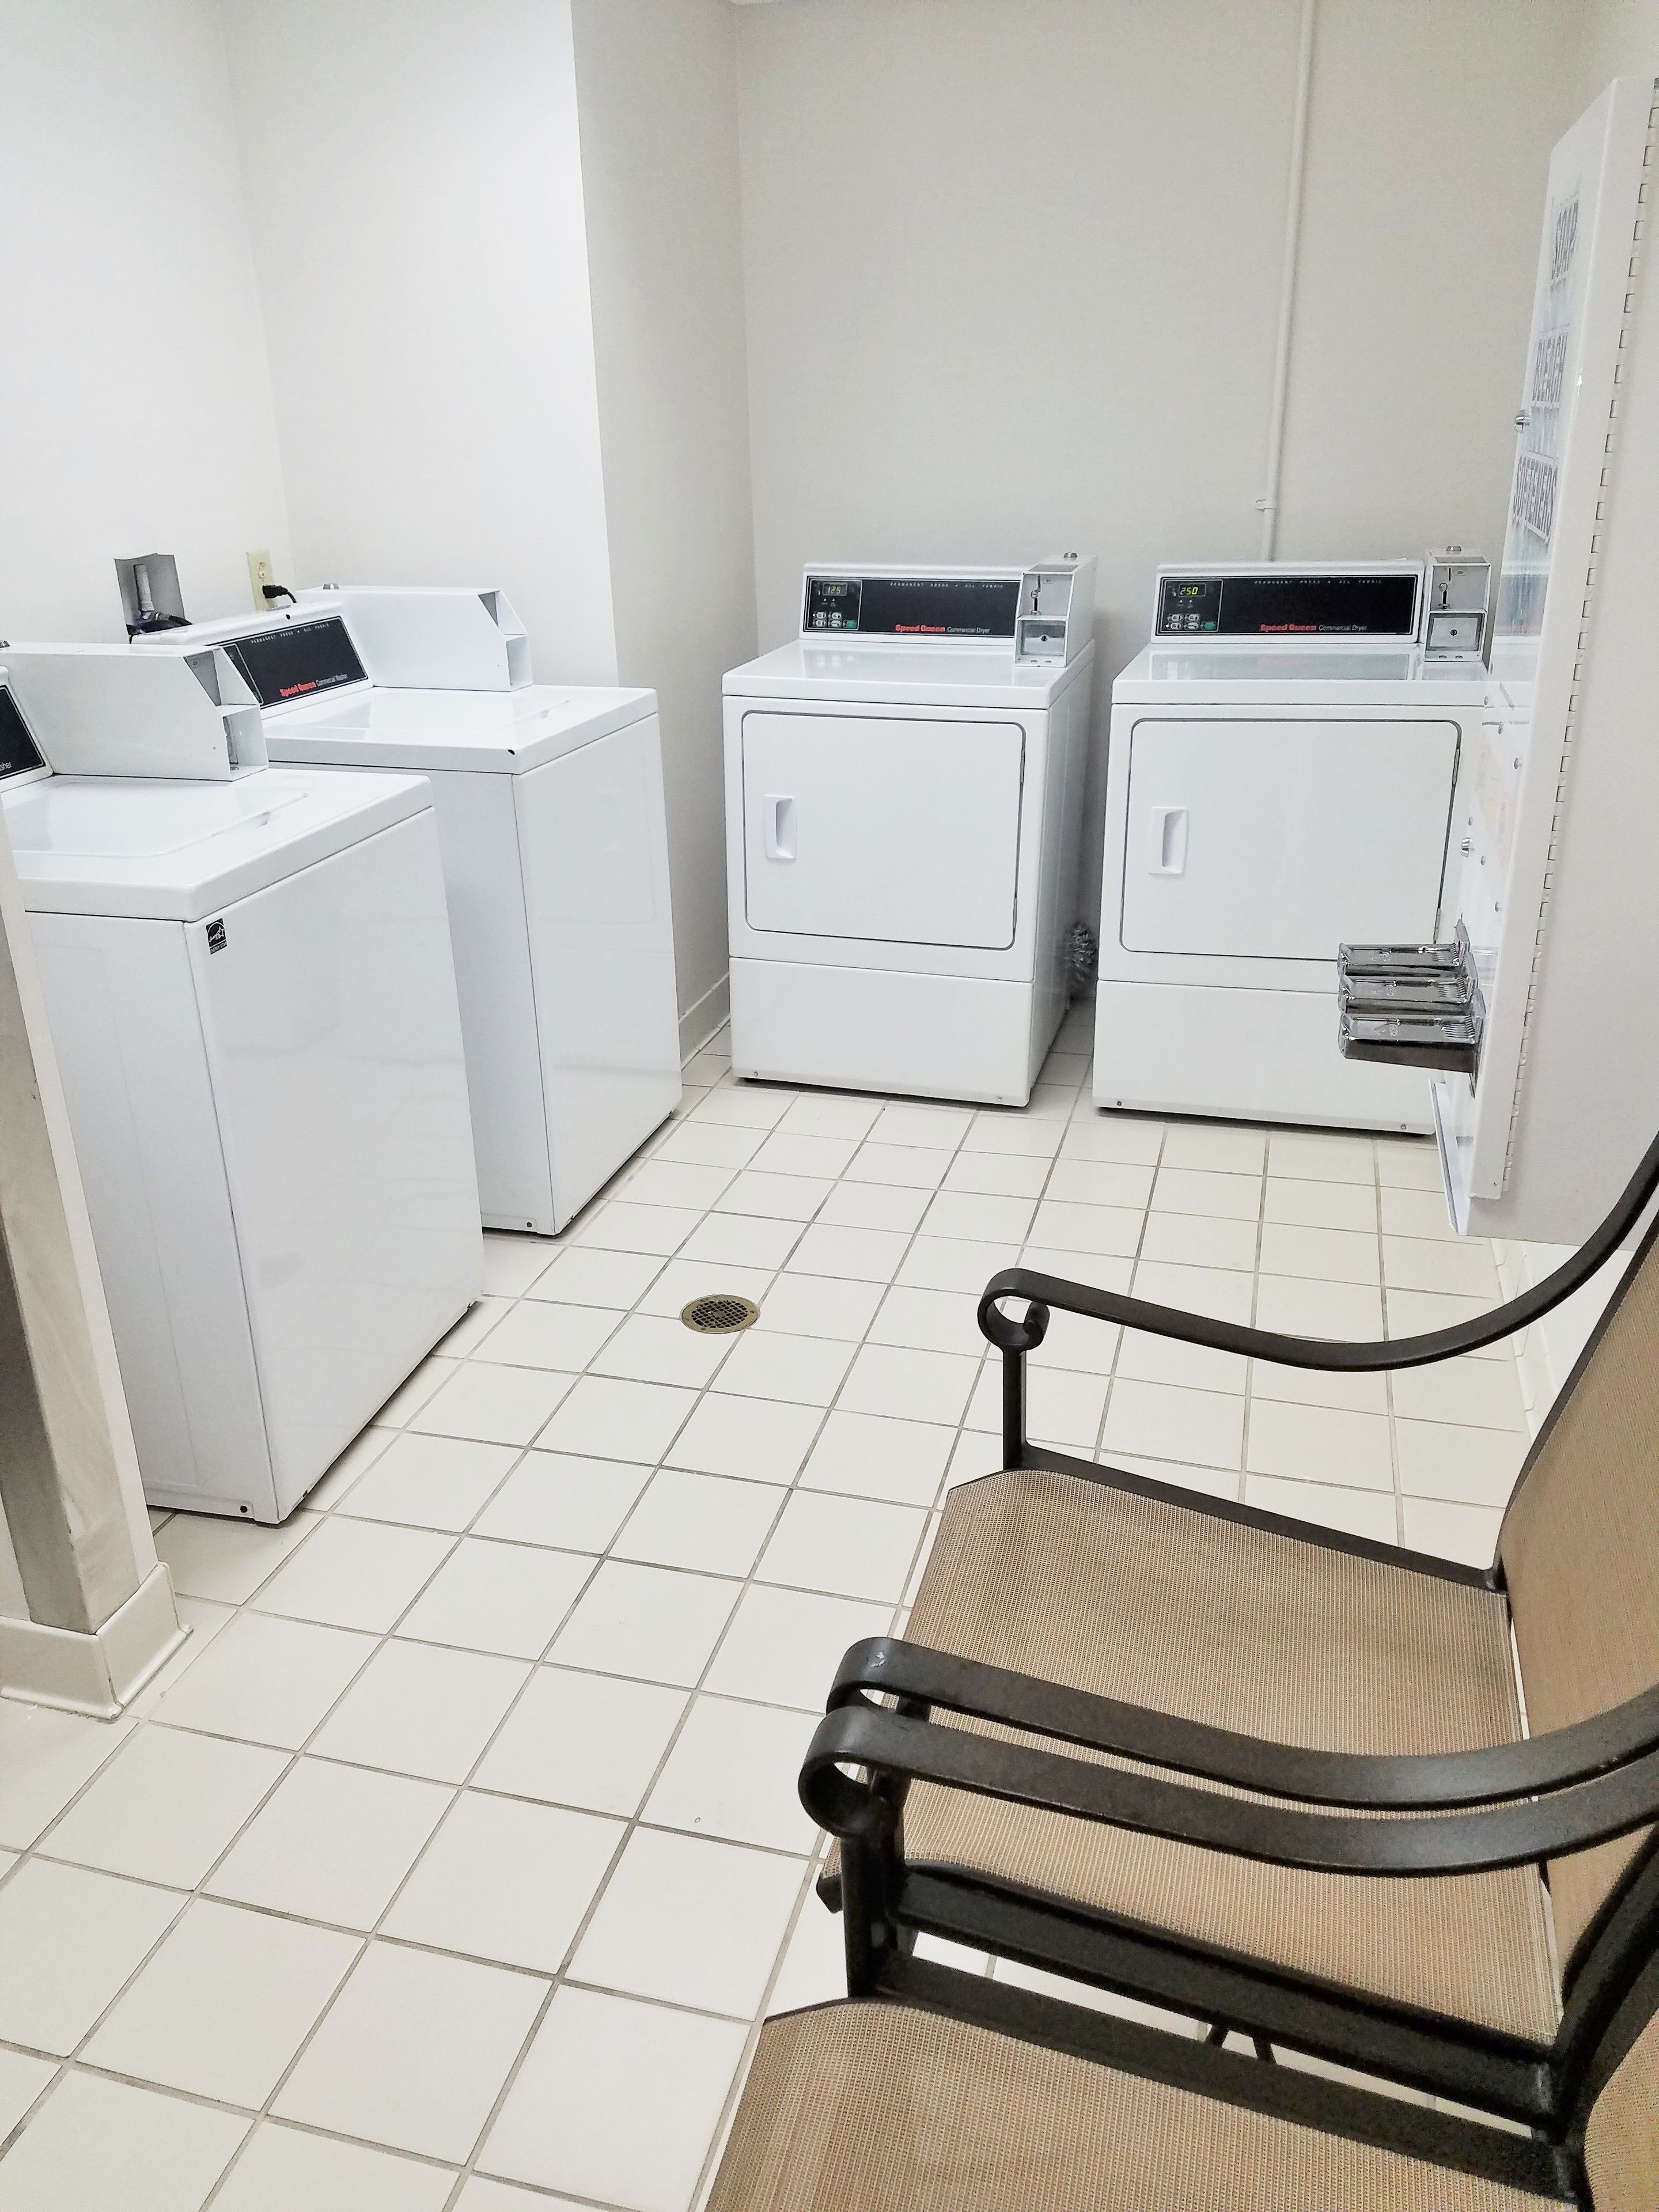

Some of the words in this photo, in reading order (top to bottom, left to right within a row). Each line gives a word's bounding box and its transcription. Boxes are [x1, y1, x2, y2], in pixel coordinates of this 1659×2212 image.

[1551, 198, 1579, 281] SOAP
[1532, 332, 1567, 403] BLEACH
[1513, 454, 1558, 538] SOFTENERS
[1180, 586, 1198, 595] 250
[895, 624, 920, 632] Speed
[1260, 624, 1288, 632] Speed
